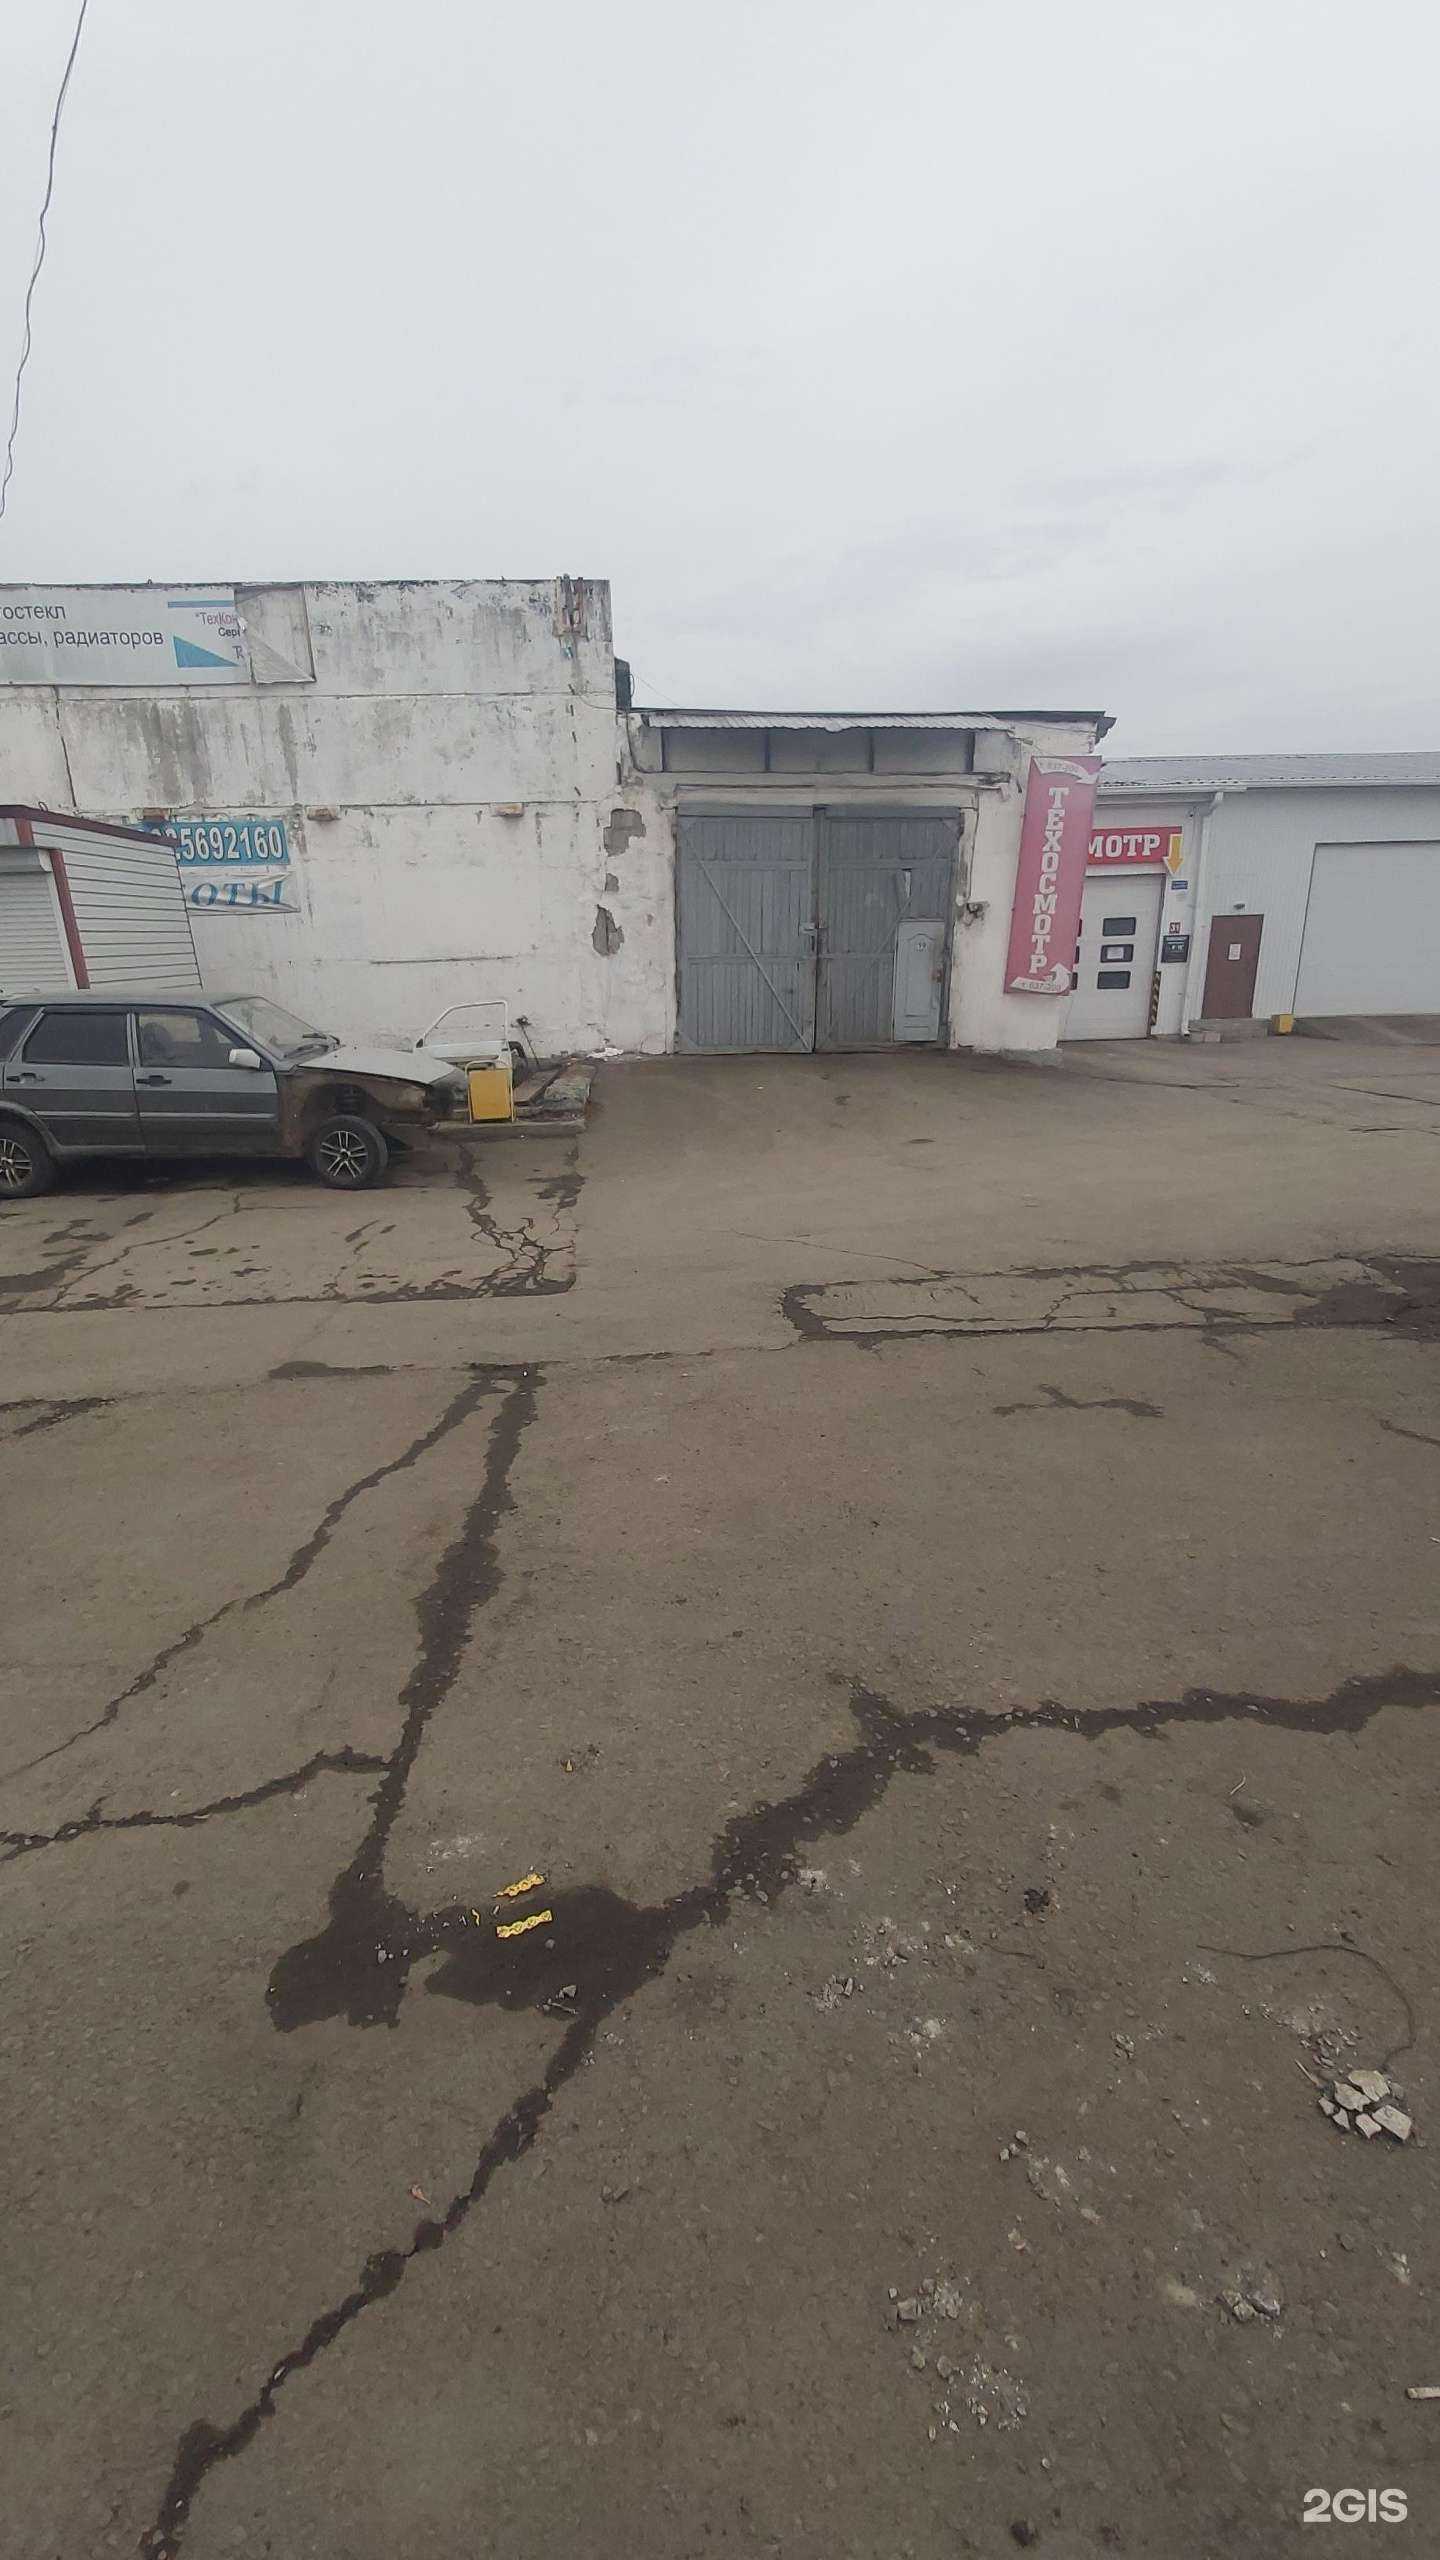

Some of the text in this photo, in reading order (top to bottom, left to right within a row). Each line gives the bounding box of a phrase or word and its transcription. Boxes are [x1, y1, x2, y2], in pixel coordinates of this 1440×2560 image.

[54, 631, 164, 649] радиаторов
[151, 827, 283, 860] 5692160
[183, 882, 283, 906] ОТЫ
[1029, 787, 1069, 974] ТЕХОСМОТР
